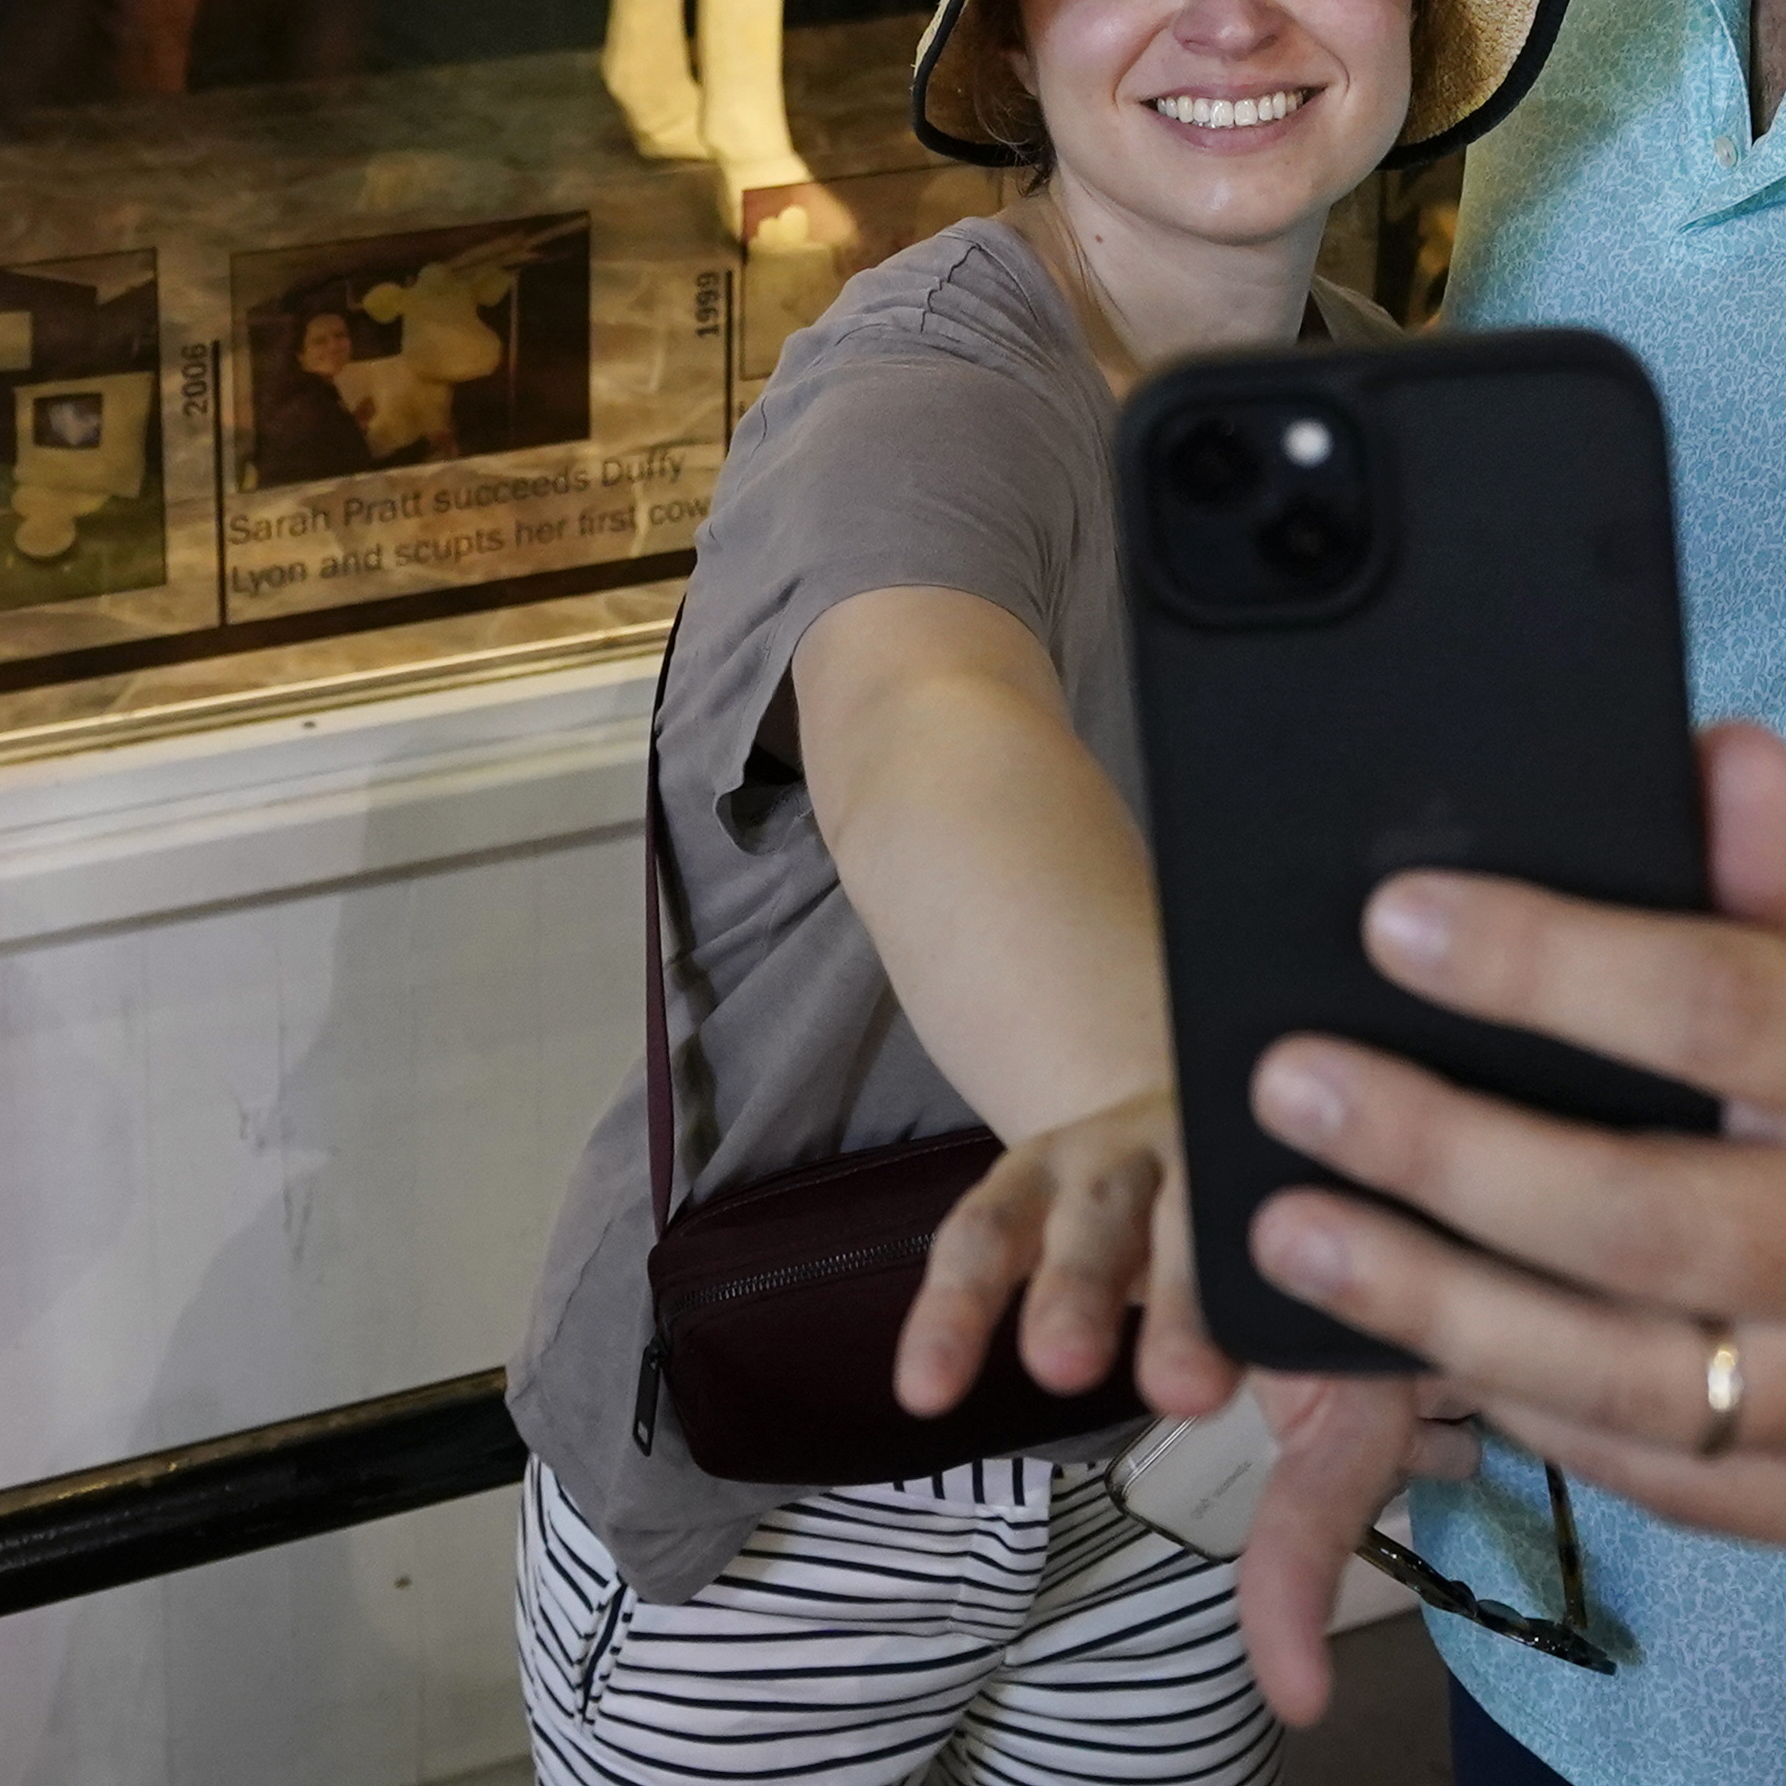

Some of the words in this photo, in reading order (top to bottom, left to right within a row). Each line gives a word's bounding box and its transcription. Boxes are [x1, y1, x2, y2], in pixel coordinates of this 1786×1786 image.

[694, 271, 722, 340] 1999
[182, 339, 211, 418] 2006
[228, 504, 332, 548] Sarah
[342, 492, 424, 531] Pratt
[433, 462, 590, 513] succeeds
[600, 447, 687, 490] Duffy
[229, 550, 309, 599] Lyon
[318, 541, 386, 581] and
[393, 526, 507, 572] scupts
[514, 512, 567, 550] her
[576, 502, 637, 536] first
[649, 497, 712, 526] cow
